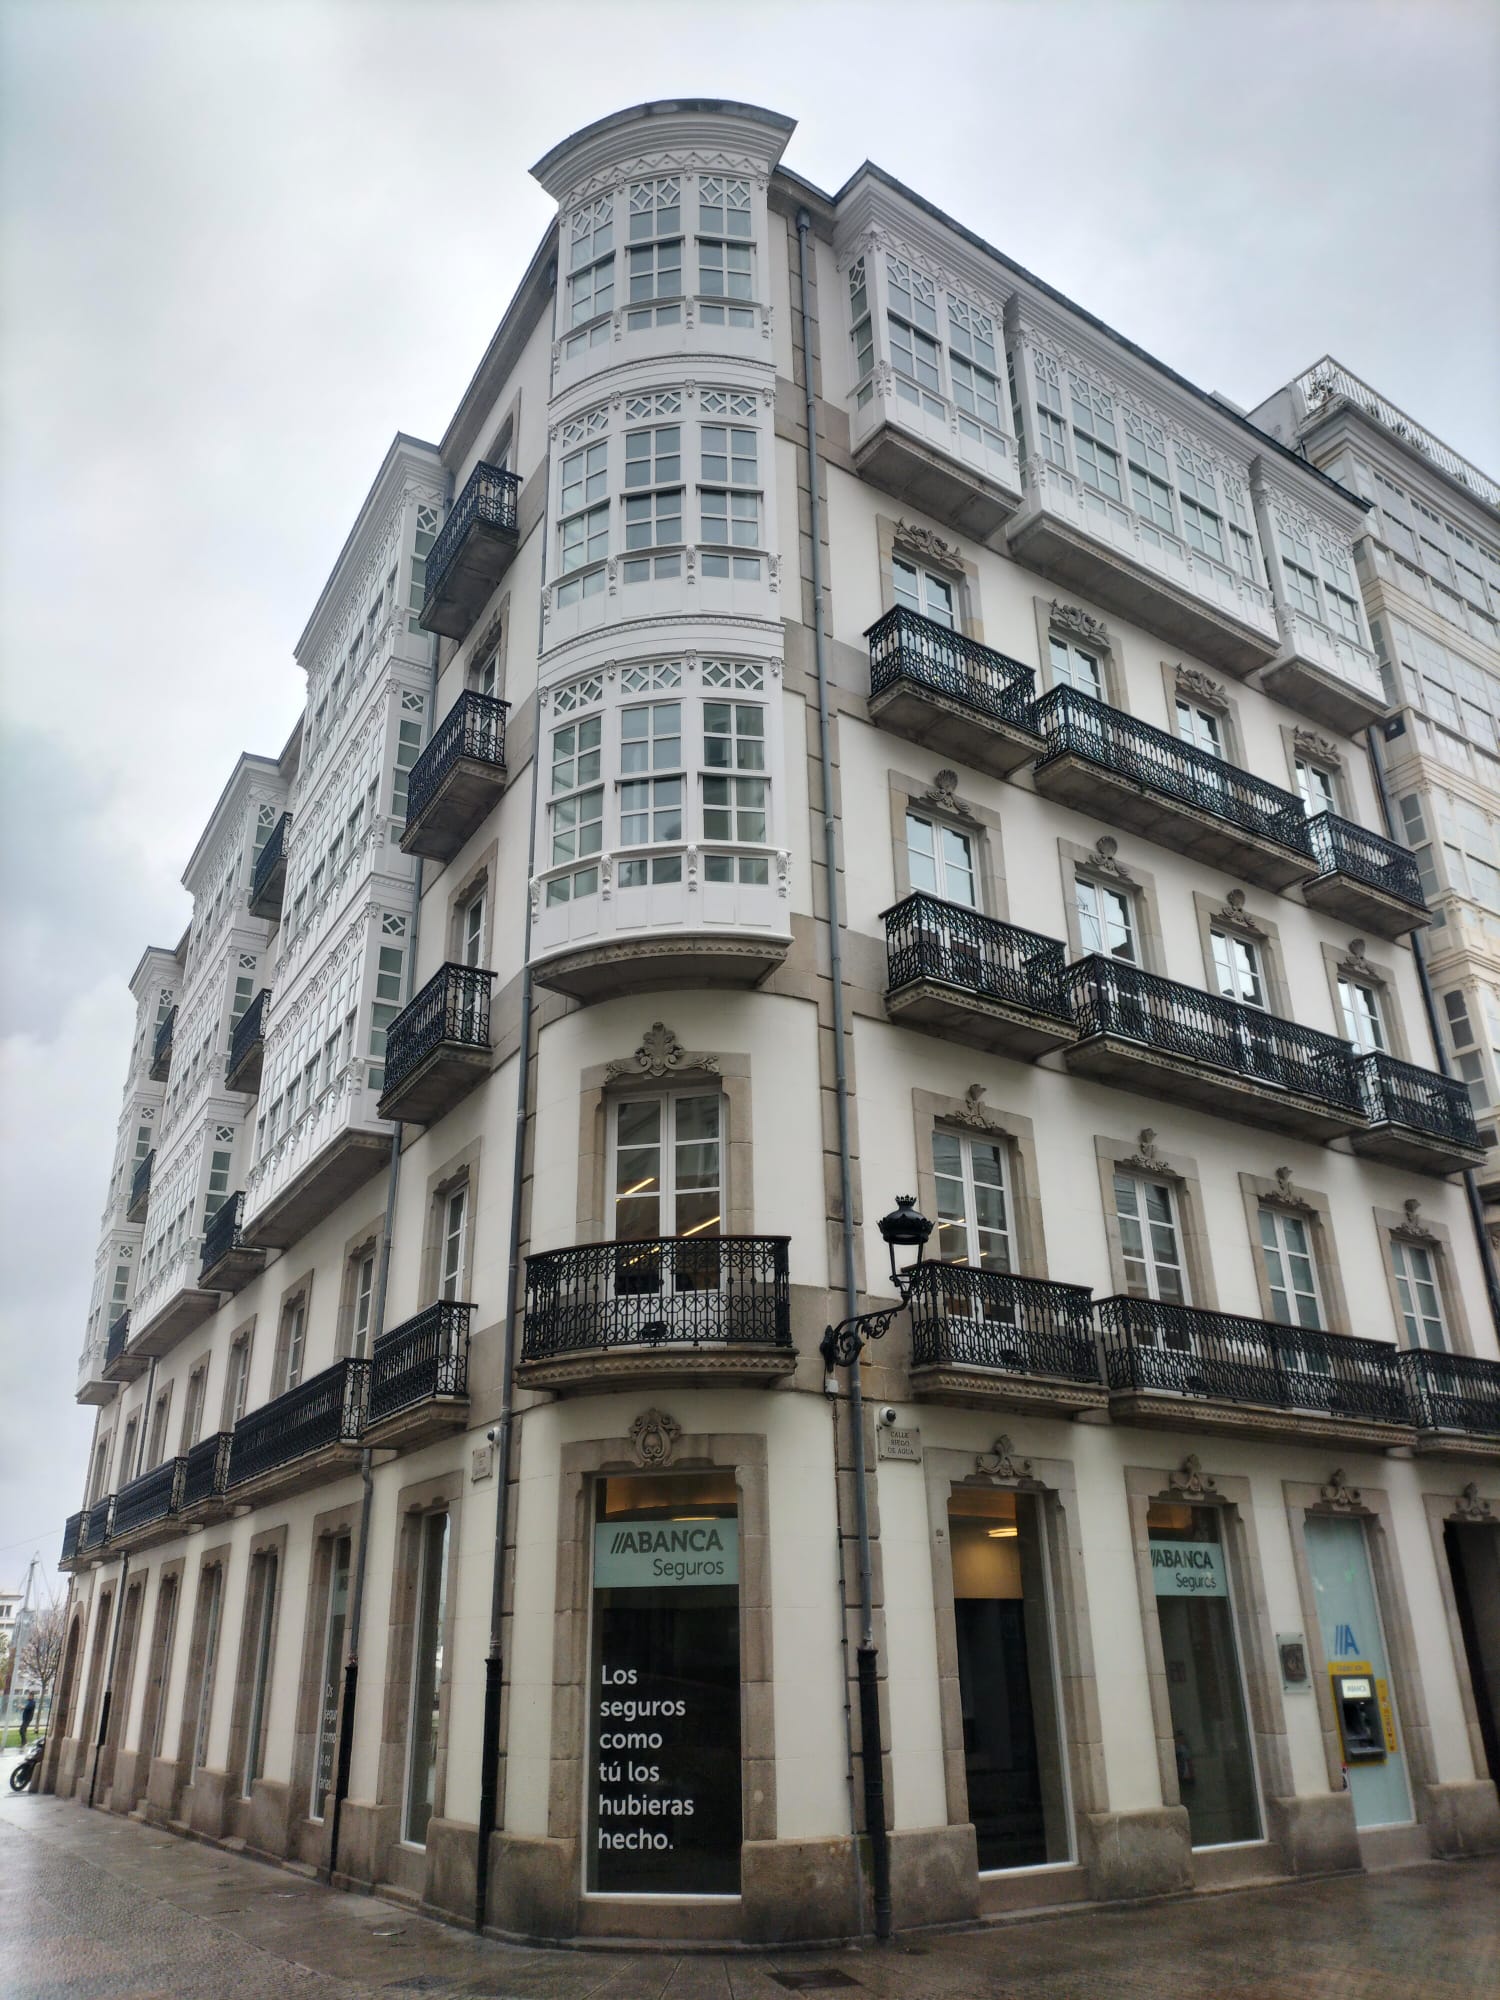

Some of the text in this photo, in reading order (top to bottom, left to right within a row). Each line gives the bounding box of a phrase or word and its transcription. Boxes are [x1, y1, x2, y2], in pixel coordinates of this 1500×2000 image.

[653, 1558, 725, 1581] Seguros
[1175, 1572, 1217, 1593] Seguros
[601, 1664, 639, 1686] Los
[599, 1699, 687, 1723] seguros
[598, 1732, 664, 1750] como
[598, 1760, 661, 1783] tú los
[598, 1794, 695, 1817] hubieras
[597, 1827, 675, 1851] hecho.
